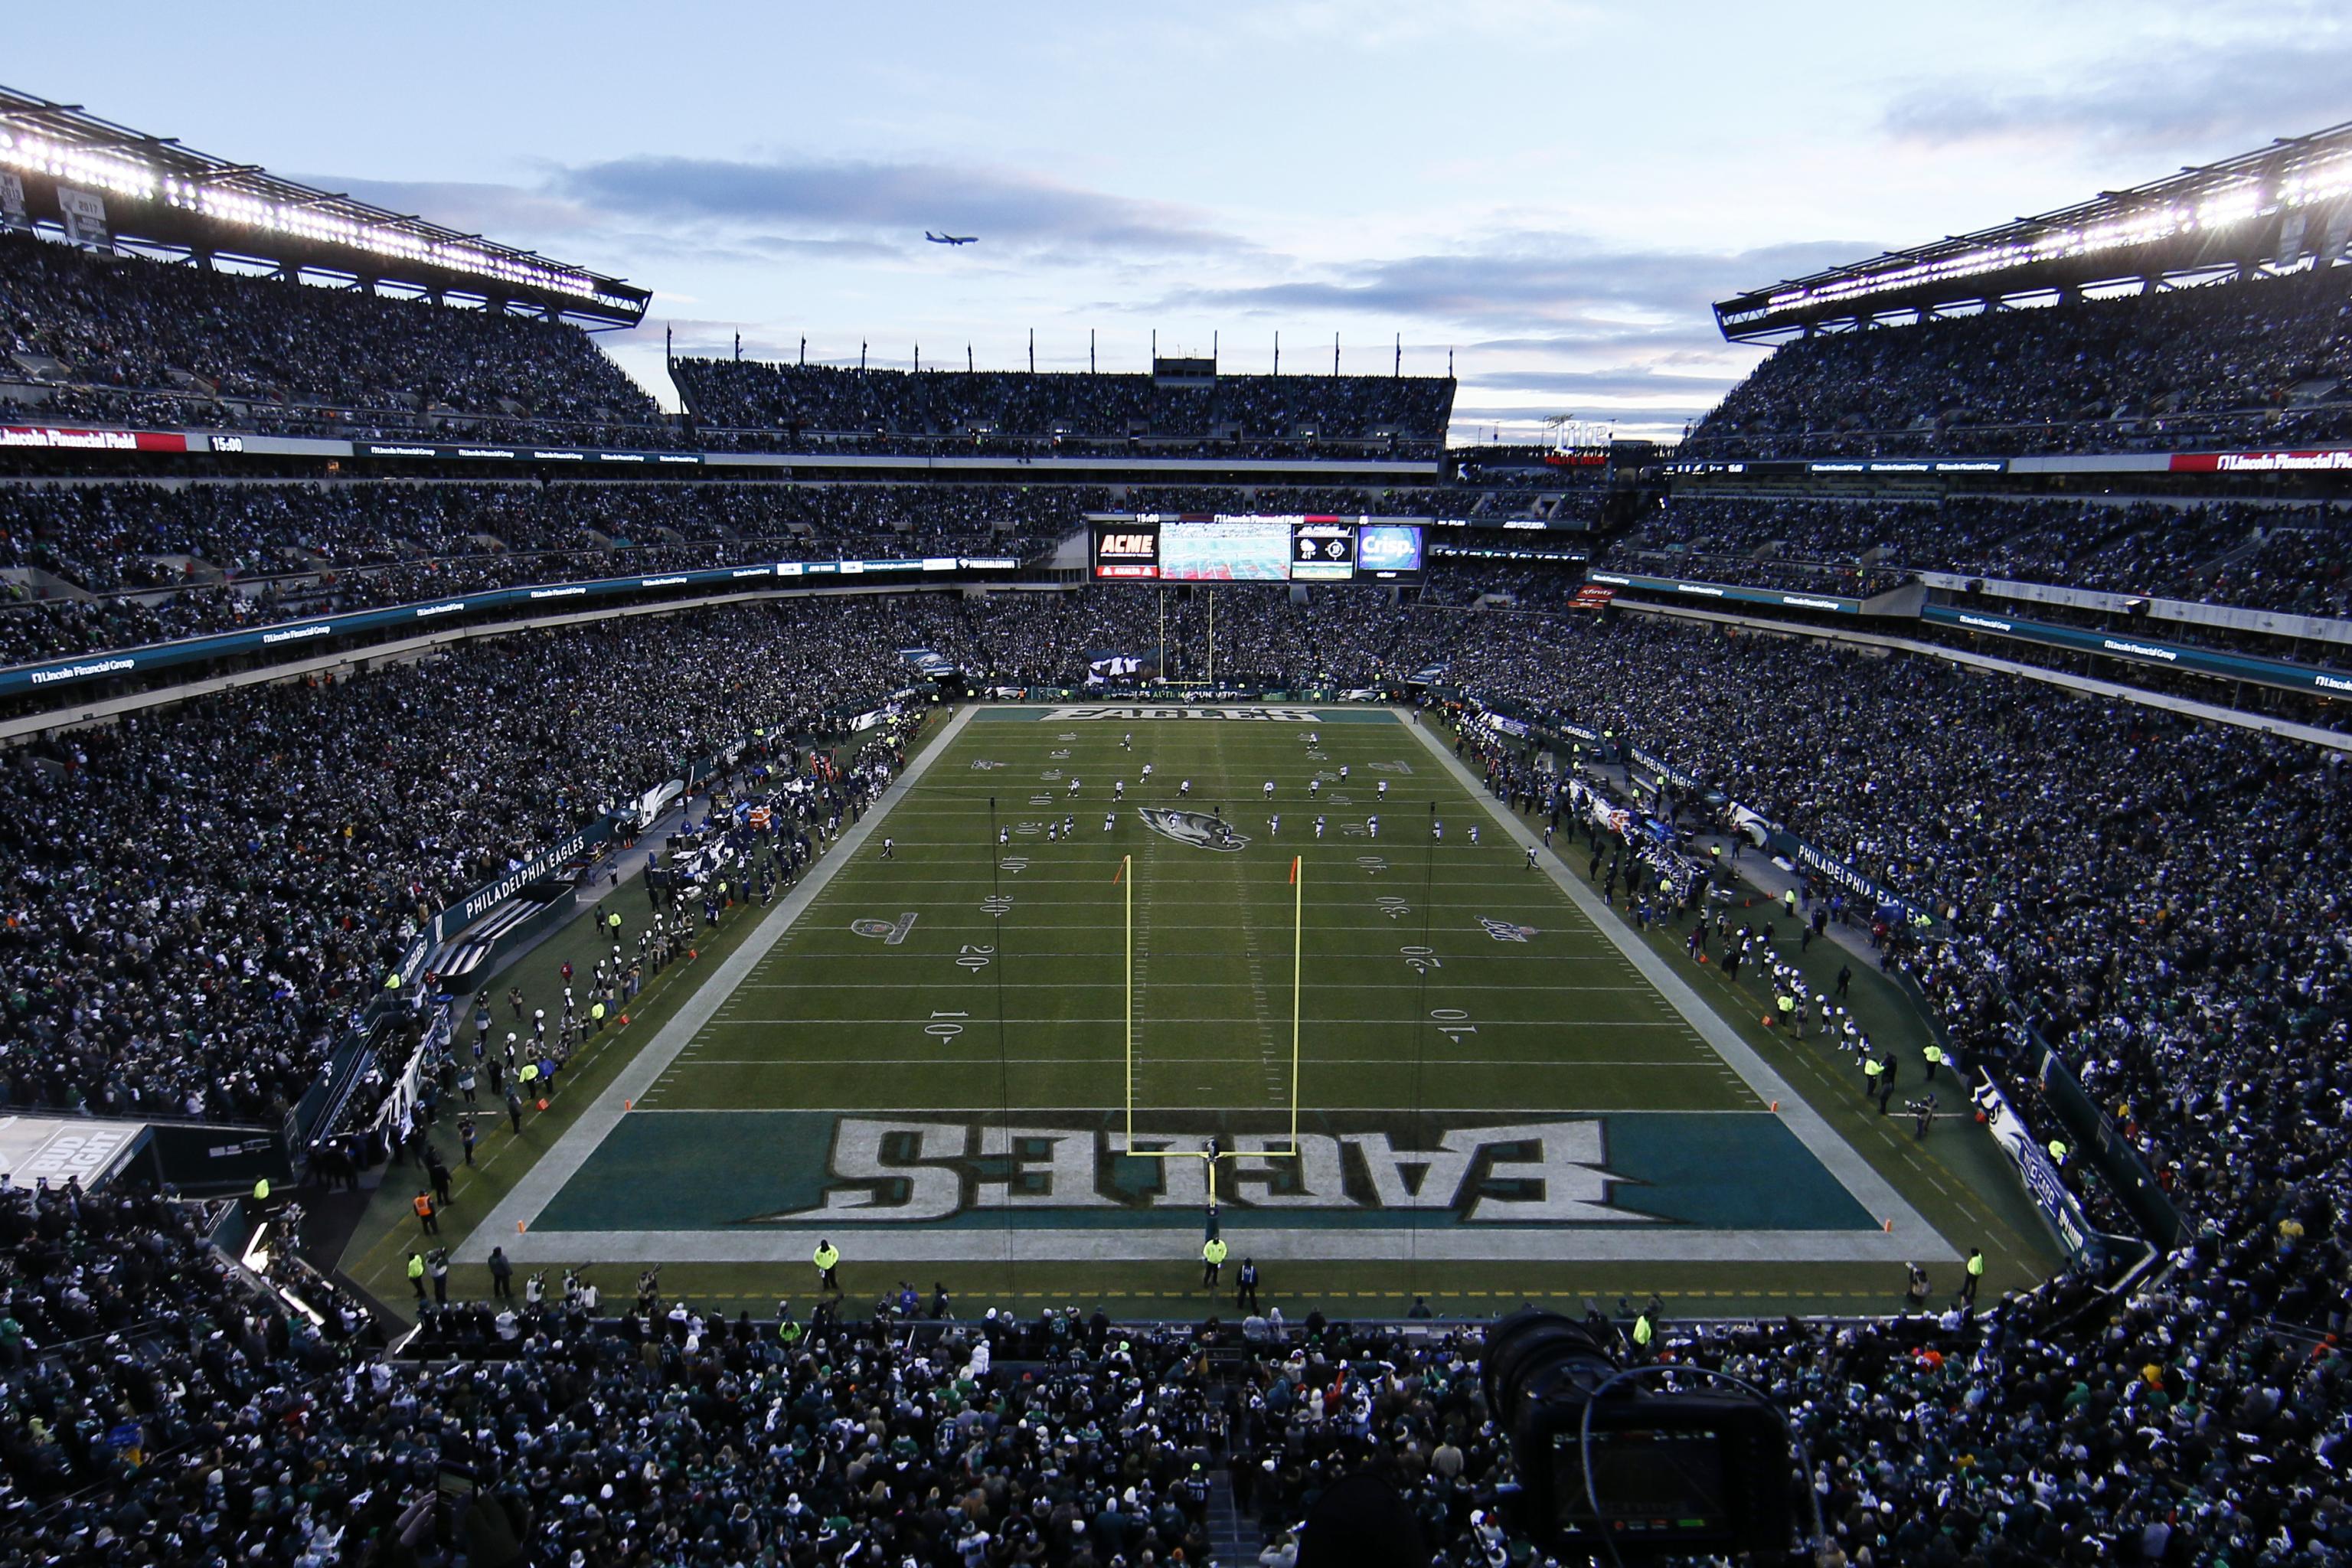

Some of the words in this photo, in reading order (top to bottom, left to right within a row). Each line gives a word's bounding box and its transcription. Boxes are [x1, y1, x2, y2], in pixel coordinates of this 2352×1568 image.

[47, 430, 106, 449] Financial
[104, 432, 137, 449] Field
[212, 437, 243, 452] 15:00
[2230, 454, 2274, 469] Lincoln
[2275, 453, 2334, 469] Financial
[1223, 514, 1250, 524] Lincoln
[1250, 514, 1284, 524] Financial
[1581, 589, 1612, 597] xfinity
[1038, 709, 1323, 722] EAGLES
[999, 855, 1029, 870] 40
[1356, 857, 1388, 870] 40
[1799, 844, 1871, 897] PHILADELPHIA
[466, 862, 547, 920] PHILADELPHIA
[550, 835, 584, 867] EAGLES
[979, 895, 1014, 913] 30
[1375, 897, 1410, 914] 30
[956, 945, 995, 966] 20
[1400, 946, 1442, 969] 20
[924, 1011, 969, 1035] 10
[1430, 1009, 1478, 1034] 10
[28, 1136, 86, 1172] BUD
[51, 1131, 123, 1182] LIGHT
[766, 1119, 1673, 1224] EAGLES
[944, 1428, 955, 1442] 11
